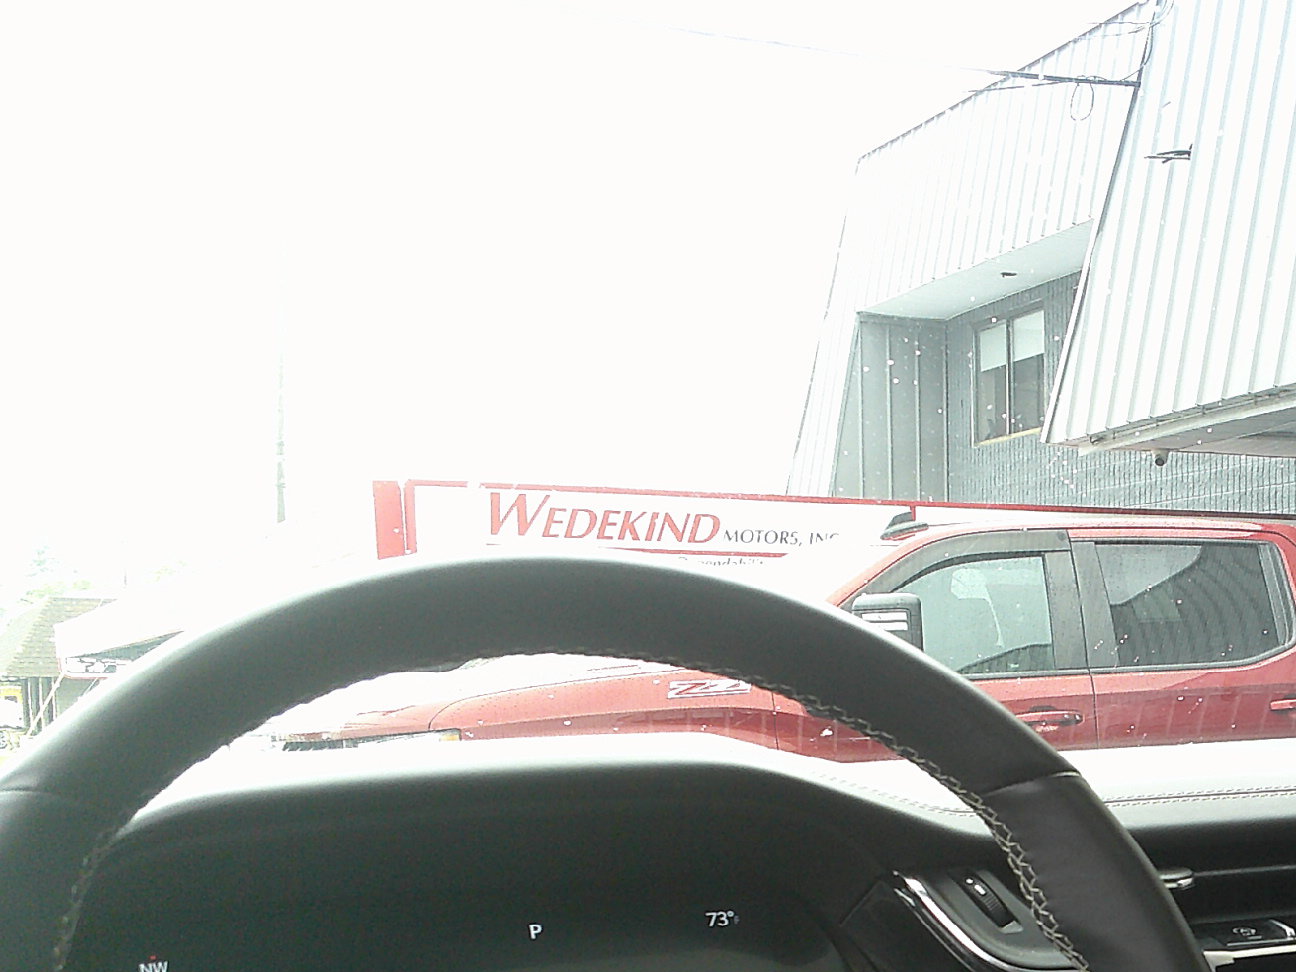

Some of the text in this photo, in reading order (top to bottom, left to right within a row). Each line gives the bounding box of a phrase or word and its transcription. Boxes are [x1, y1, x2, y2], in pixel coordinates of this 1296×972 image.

[490, 492, 721, 544] WEDEKIND
[724, 529, 802, 546] MOTORS,
[529, 923, 543, 941] P
